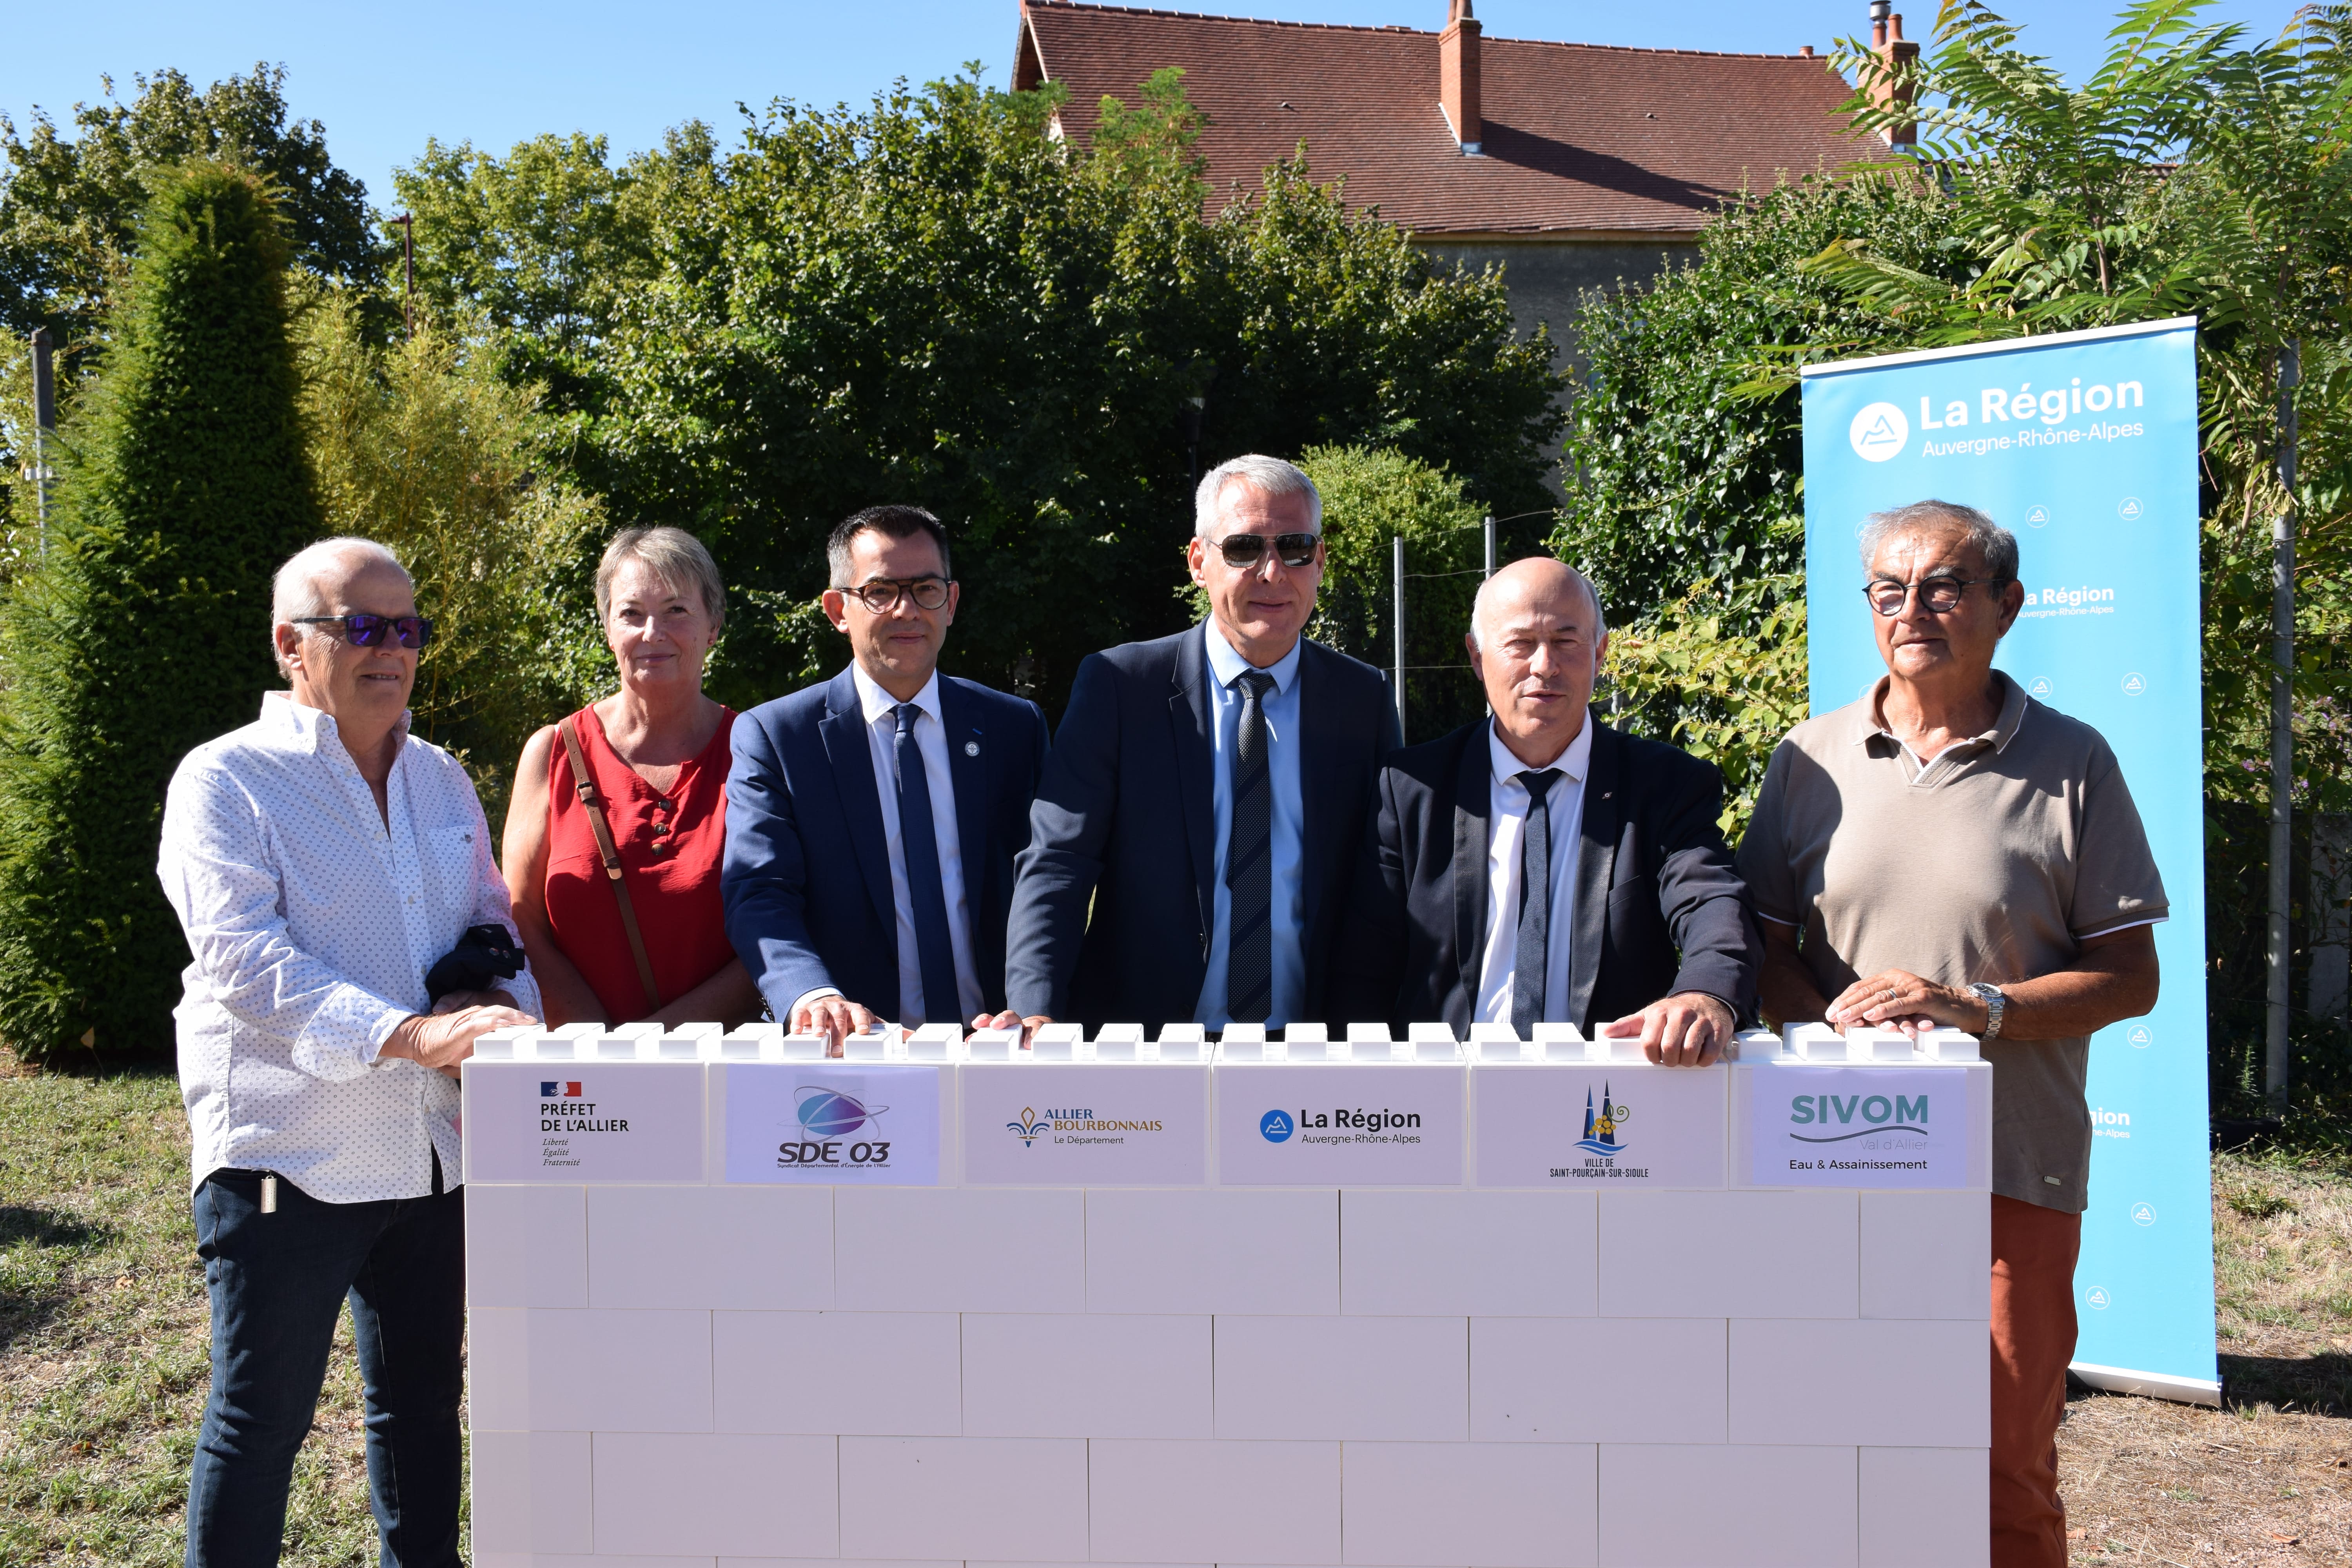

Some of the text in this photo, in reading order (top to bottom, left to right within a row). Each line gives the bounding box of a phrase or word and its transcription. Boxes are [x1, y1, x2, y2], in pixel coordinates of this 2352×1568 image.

[1920, 377, 2143, 430] La Région
[1922, 422, 2143, 457] Auvergne-Rhône-Alpes
[2023, 586, 2114, 606] a Région
[541, 1101, 596, 1115] PRÉFET
[1790, 1095, 1928, 1124] SIVOM
[1044, 1109, 1094, 1119] ALLIER
[2089, 1107, 2130, 1126] gion
[541, 1120, 629, 1131] DE L'ALLIER
[1054, 1120, 1163, 1131] BOURBONNAIS
[1301, 1109, 1421, 1132] La Région
[1067, 1136, 1124, 1146] Département
[1301, 1134, 1421, 1145] Auvergne-Rhône-Alpes
[1860, 1139, 1878, 1150] Val
[1883, 1139, 1928, 1150] d'Allier
[542, 1147, 569, 1158] Égalité
[777, 1142, 890, 1163] SDE 03
[1585, 1158, 1614, 1167] VILLE DE
[1790, 1159, 1927, 1169] Eau & Assainissement
[1550, 1168, 1649, 1178] SAINT-POURÇAIN-SUR-SIOULE
